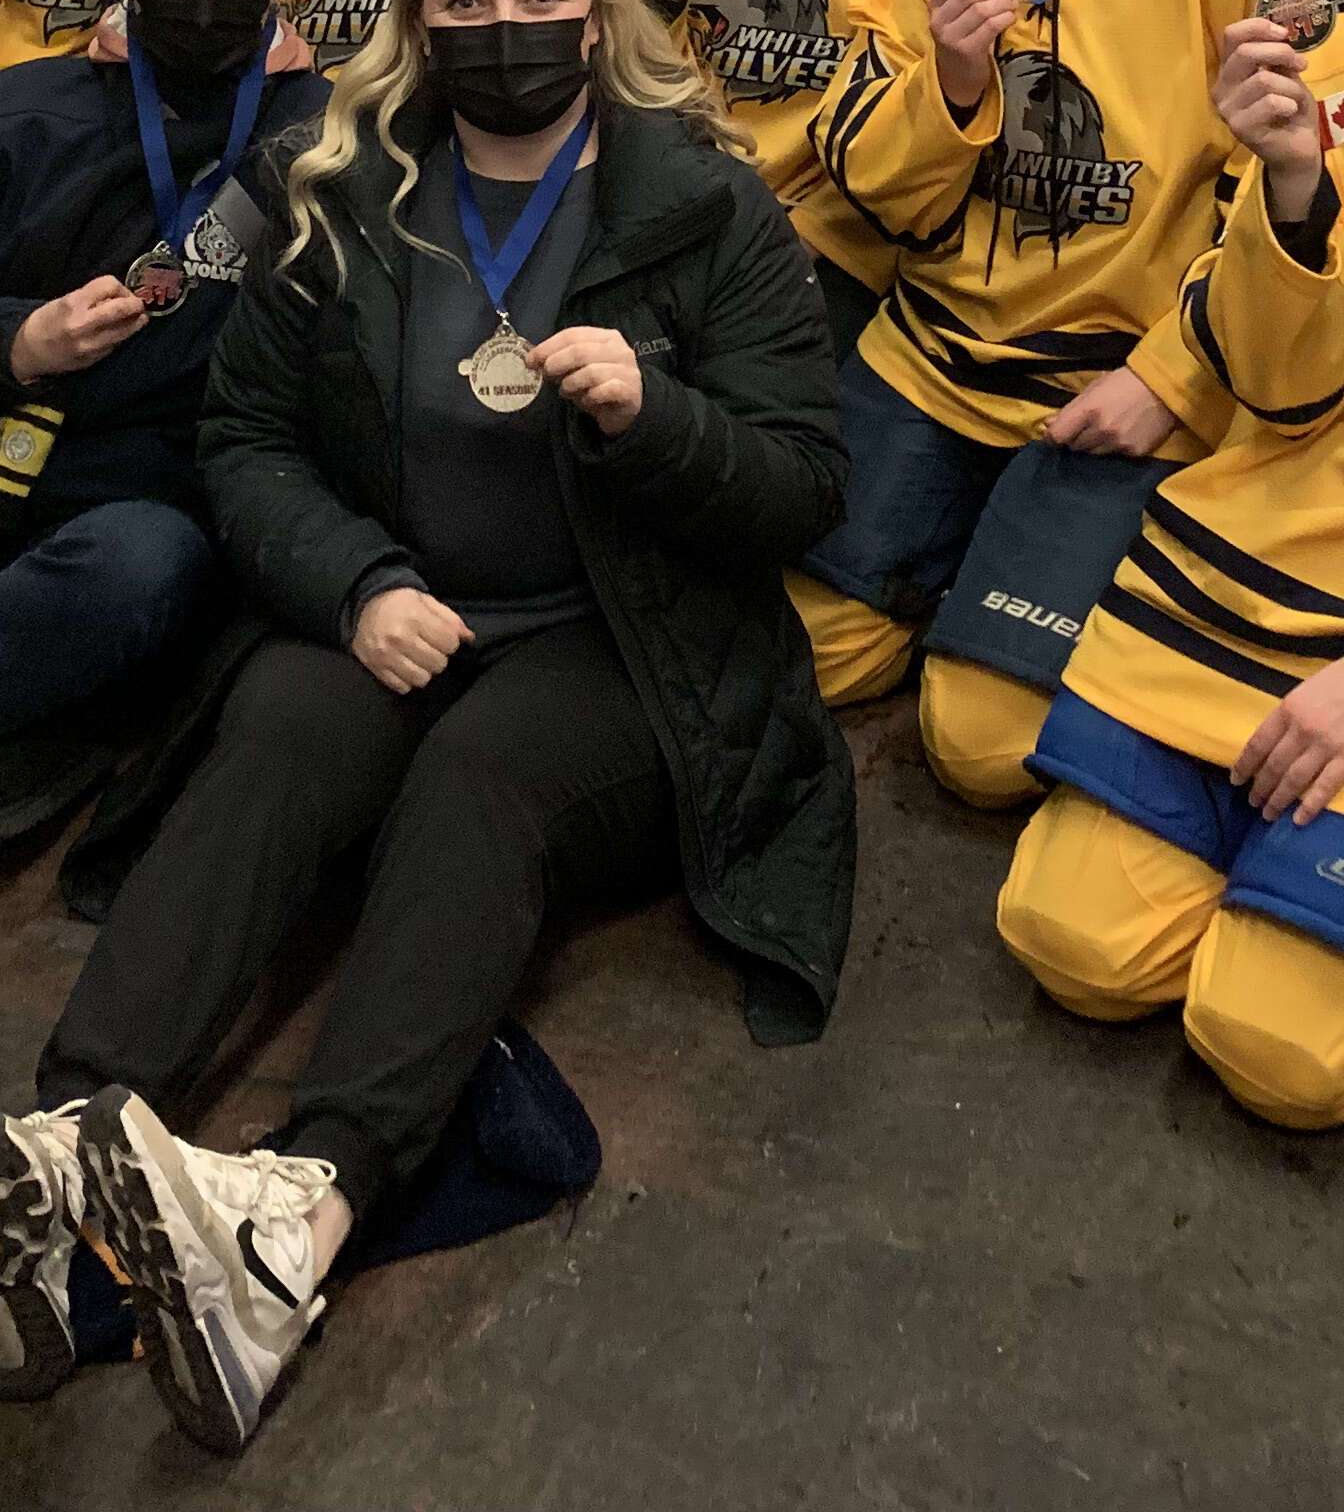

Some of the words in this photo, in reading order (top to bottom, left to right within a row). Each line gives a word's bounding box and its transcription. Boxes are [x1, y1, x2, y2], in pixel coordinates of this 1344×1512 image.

[736, 24, 854, 62] WHITBY
[709, 45, 841, 90] OLVES
[999, 173, 1135, 225] OLVES
[981, 590, 1082, 641] BAUE
